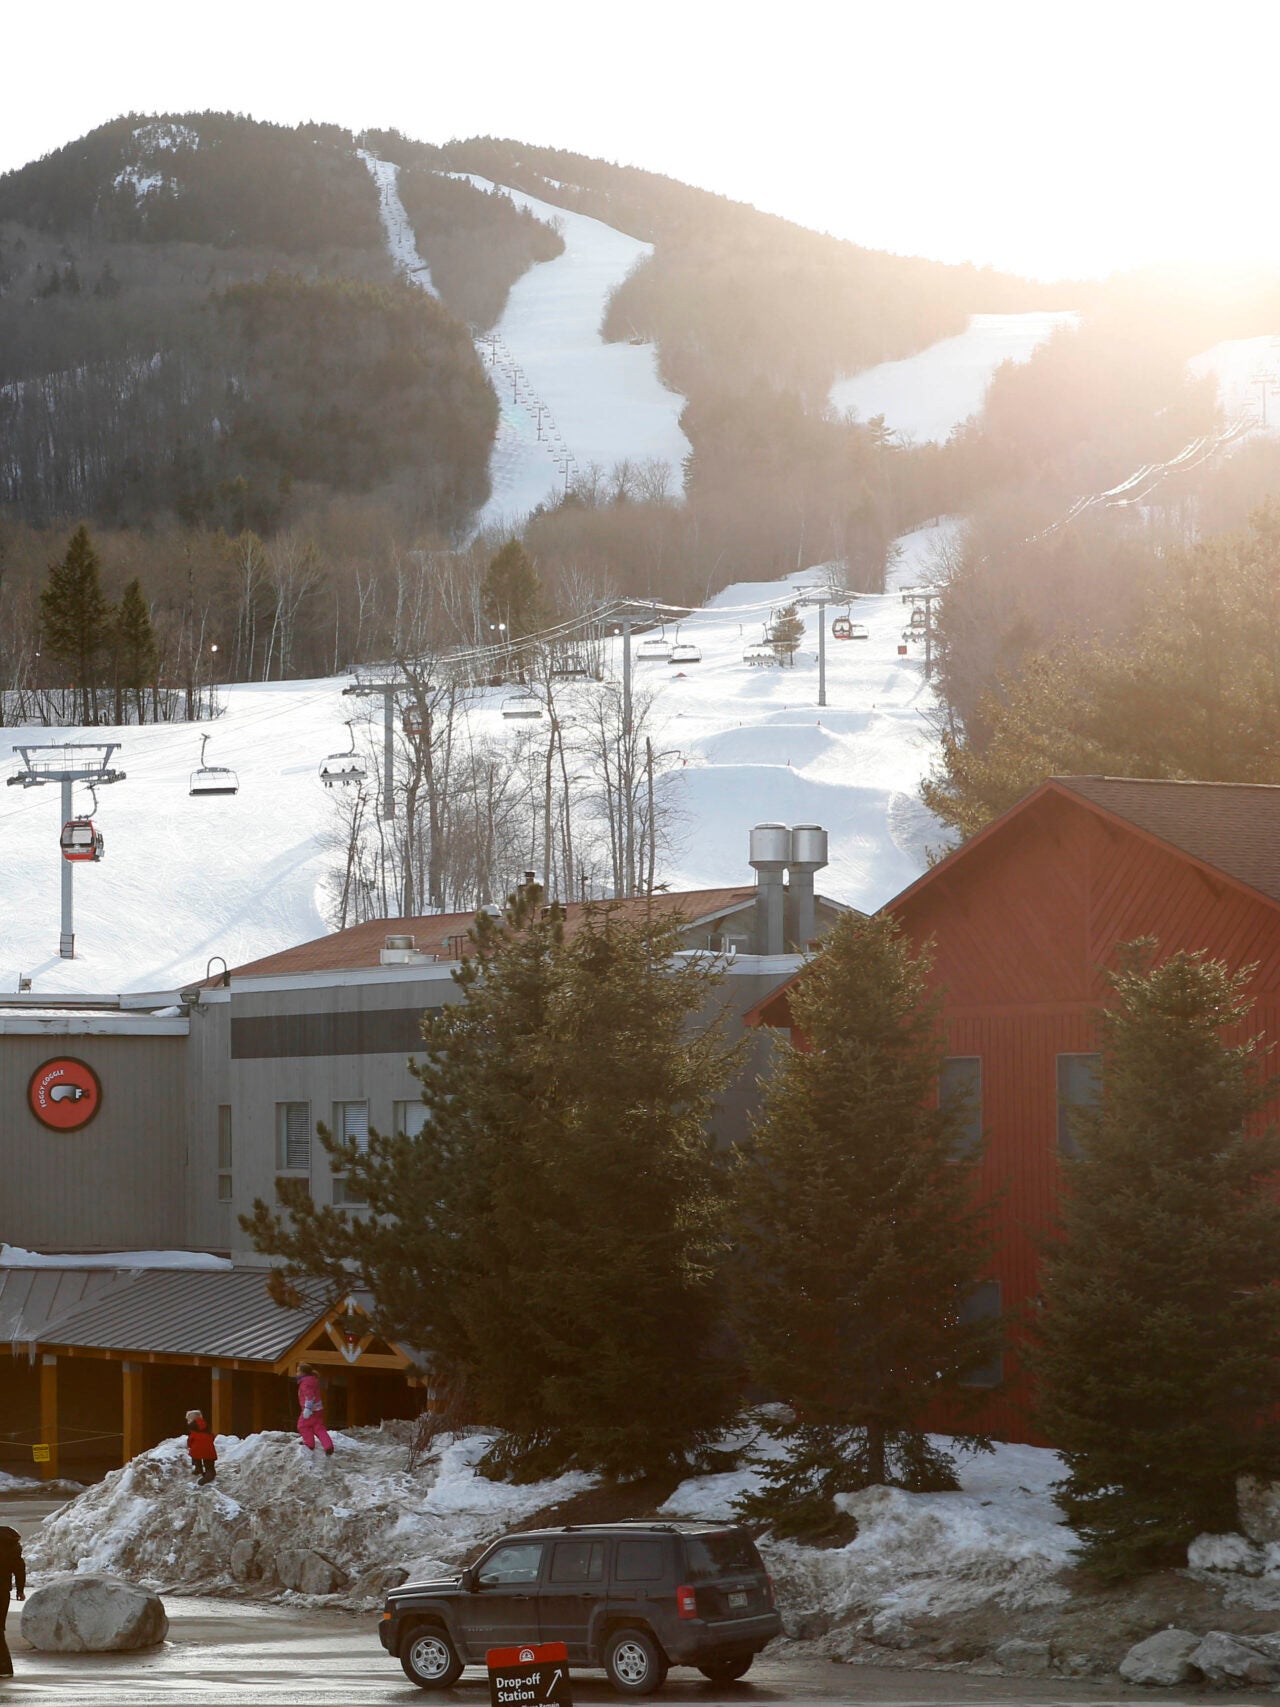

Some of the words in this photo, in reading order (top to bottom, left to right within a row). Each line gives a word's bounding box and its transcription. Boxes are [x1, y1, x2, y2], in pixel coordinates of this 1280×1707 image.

[42, 1070, 64, 1085] GOGGLE
[39, 1086, 47, 1107] FOGGY
[496, 1673, 540, 1688] Drop-off
[498, 1689, 535, 1702] Station
